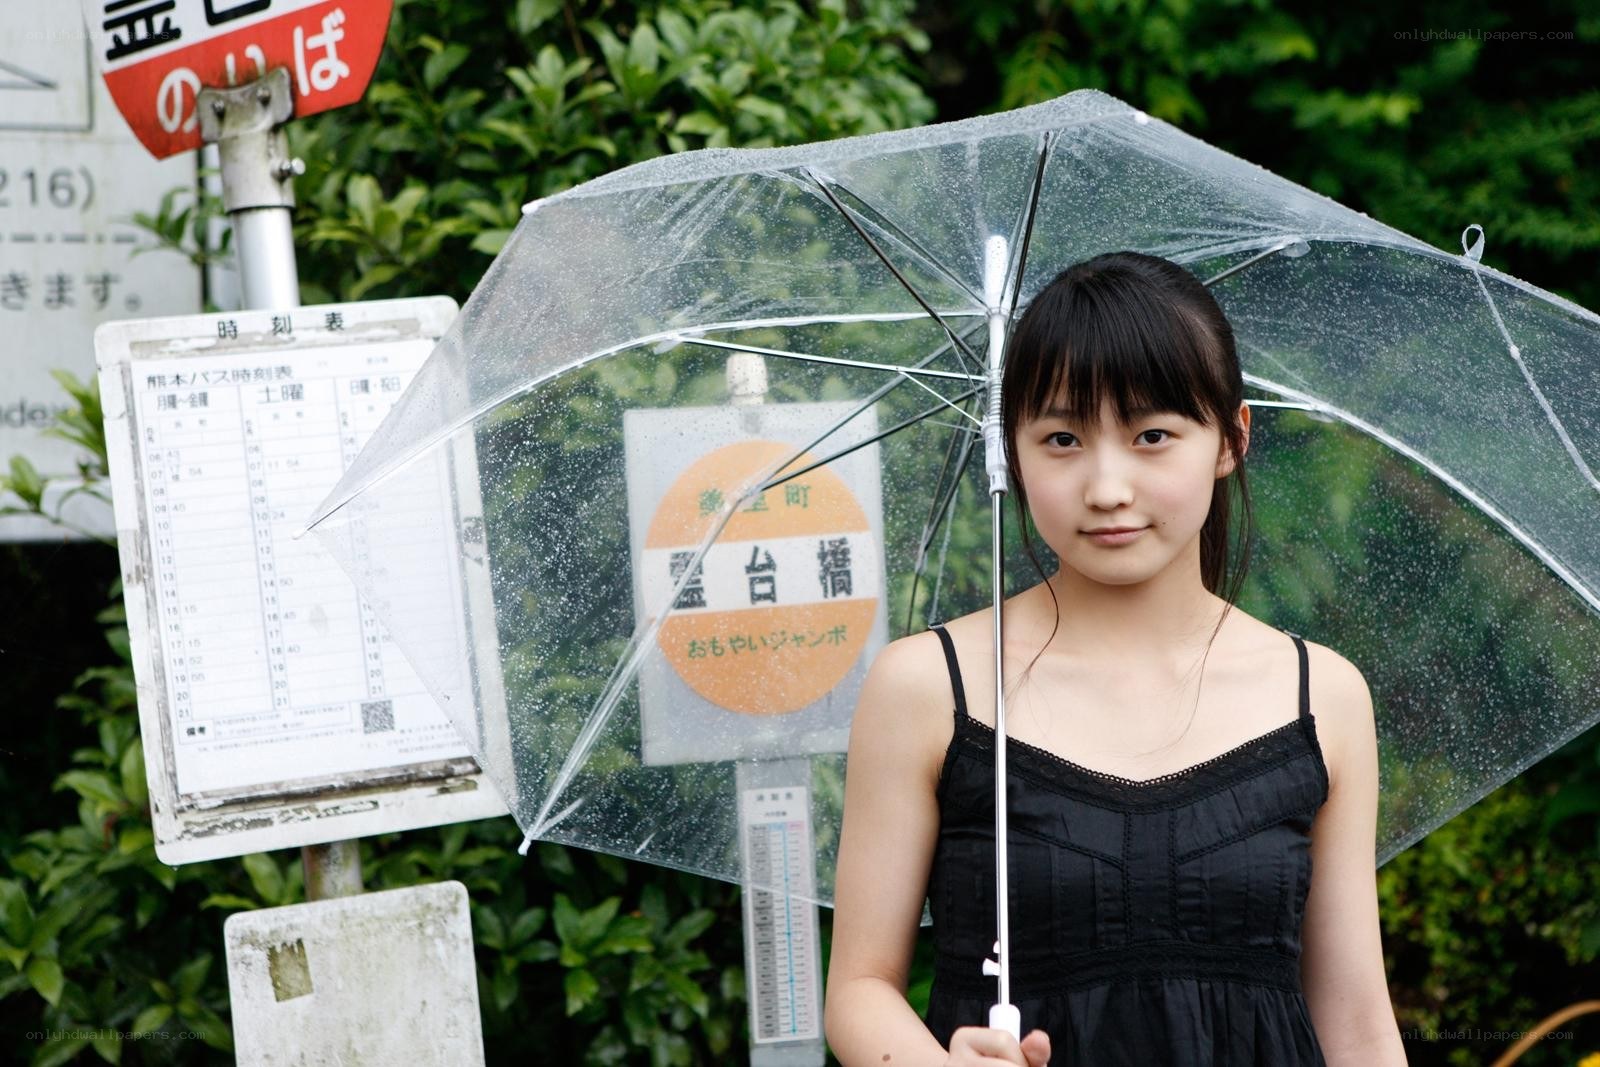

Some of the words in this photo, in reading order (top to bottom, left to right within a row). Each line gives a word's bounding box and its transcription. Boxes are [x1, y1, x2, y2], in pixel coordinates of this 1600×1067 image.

[217, 312, 344, 339] 時刻表
[147, 366, 293, 389] 熊本バス時刻表
[257, 384, 303, 404] 土曜
[688, 625, 847, 659] おもやいジャンボ
